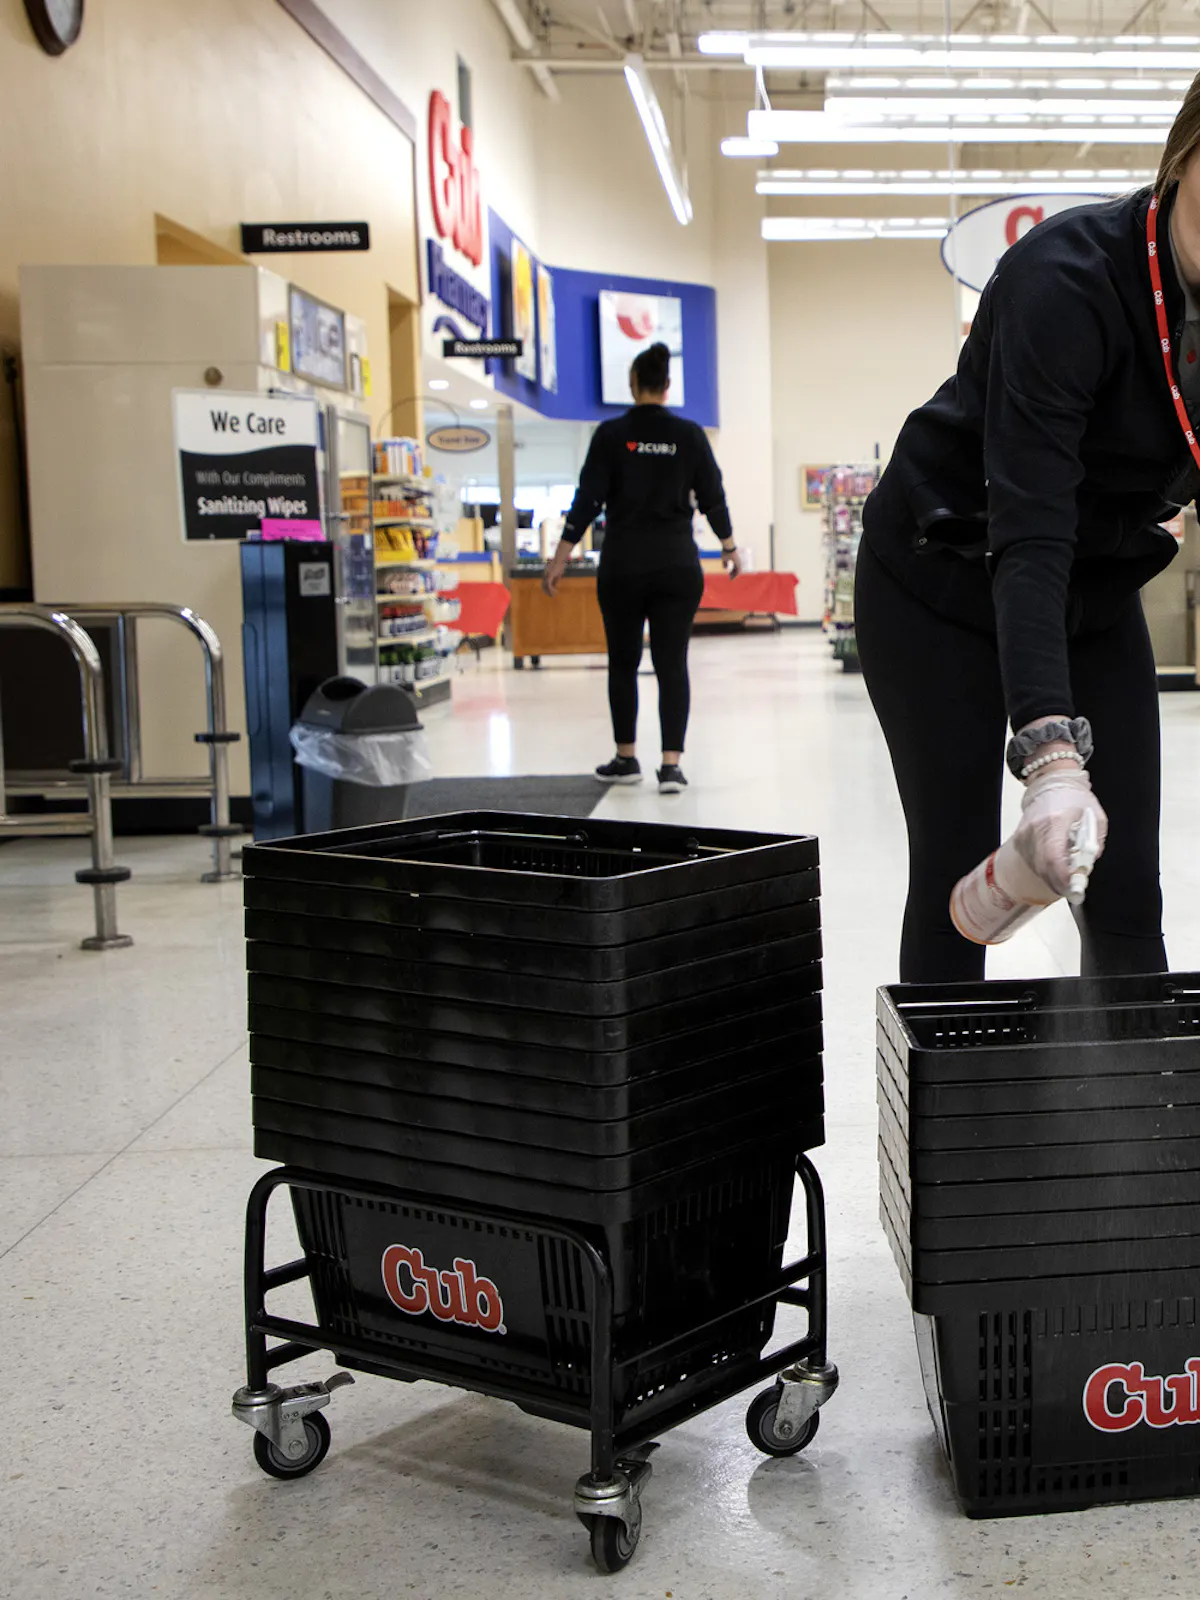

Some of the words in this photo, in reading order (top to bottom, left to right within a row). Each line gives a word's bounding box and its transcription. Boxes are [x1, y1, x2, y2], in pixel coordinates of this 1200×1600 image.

[262, 228, 361, 247] Restrooms
[453, 342, 518, 355] Restrooms
[210, 410, 241, 433] We
[246, 413, 286, 435] Care
[195, 470, 221, 486] With
[222, 471, 241, 485] Our
[242, 471, 306, 488] Compliments
[197, 496, 266, 519] Sanitizing
[267, 497, 308, 518] Wipes
[381, 1244, 503, 1333] Cub
